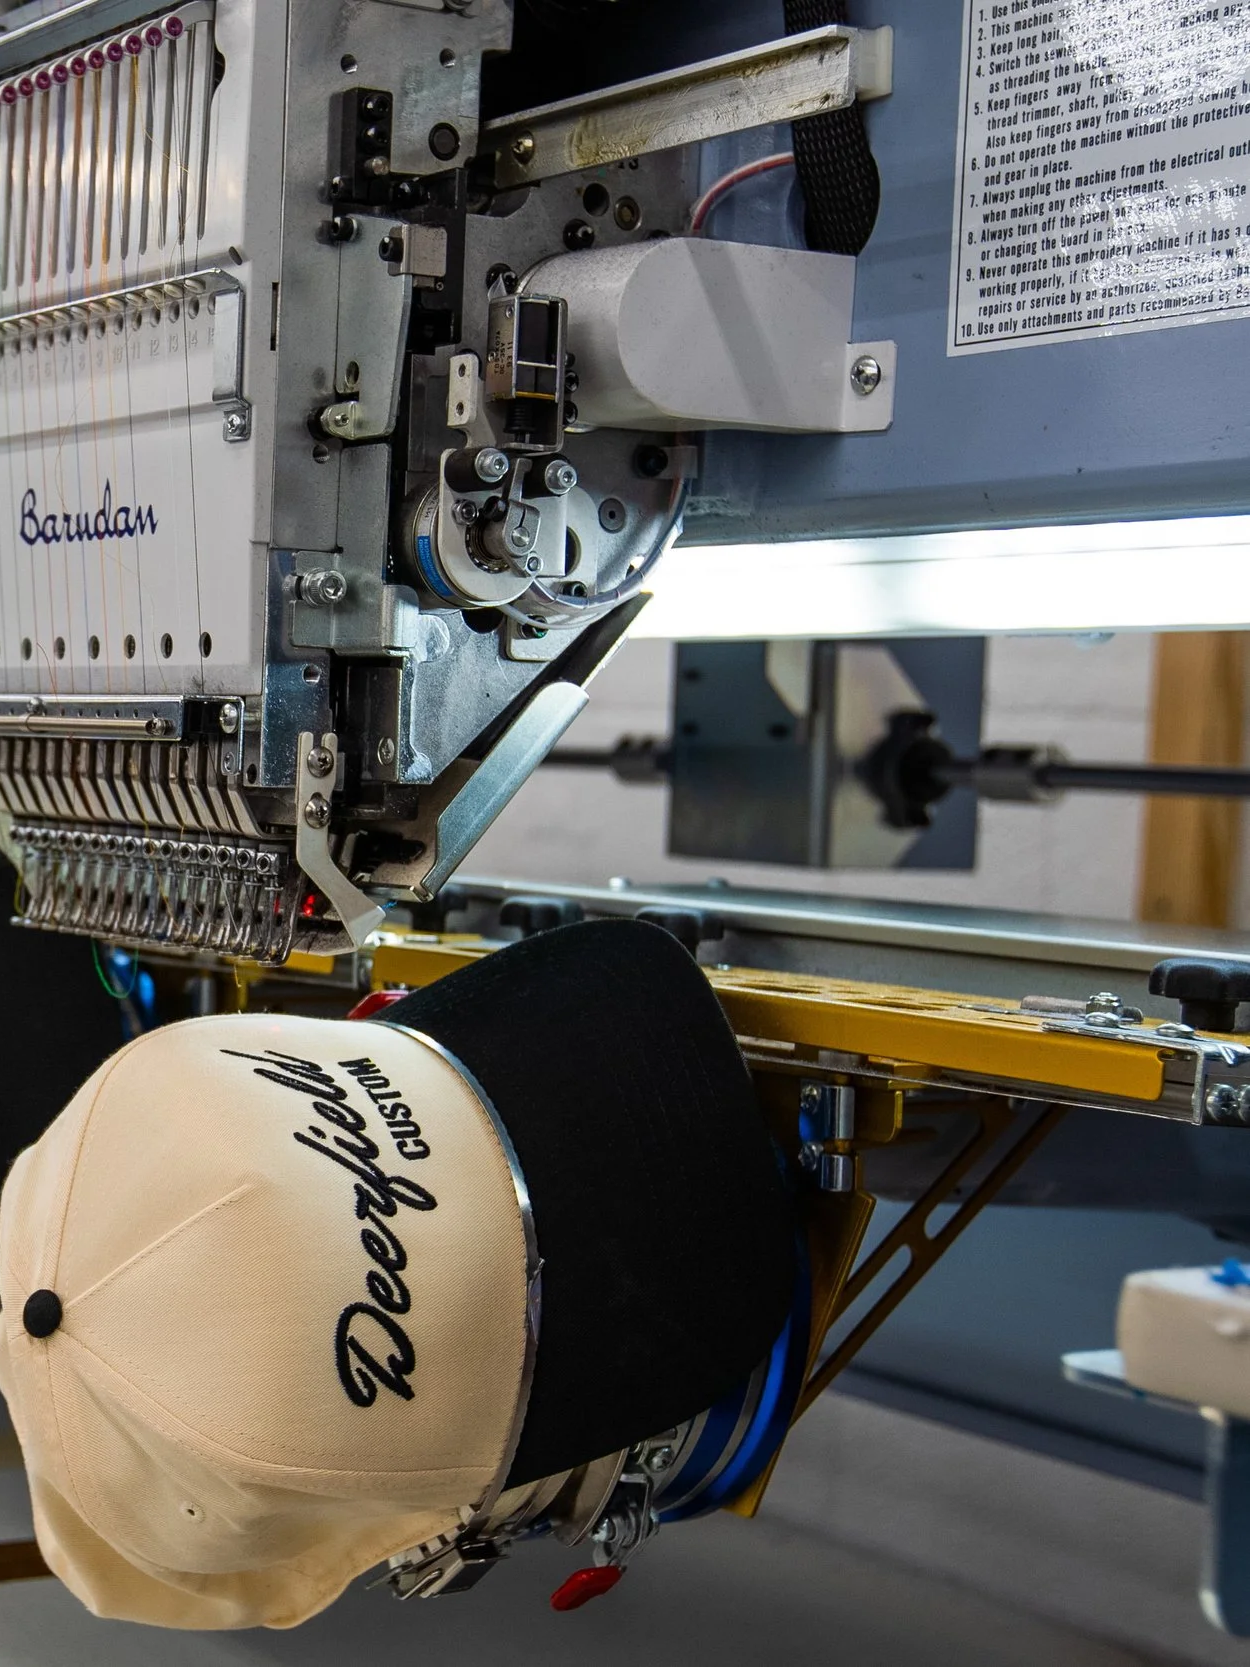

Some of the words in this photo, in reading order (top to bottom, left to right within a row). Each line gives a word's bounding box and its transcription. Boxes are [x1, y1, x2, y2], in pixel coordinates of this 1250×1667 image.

[979, 9, 987, 22] 1.
[992, 5, 1008, 20] Use
[977, 47, 986, 60] 3.
[990, 41, 1013, 57] Keep
[1017, 35, 1037, 49] long
[1042, 28, 1063, 44] hair,
[978, 28, 986, 41] 2.
[991, 23, 1010, 37] This
[976, 65, 985, 78] 4.
[989, 56, 1021, 76] Switch
[1025, 53, 1040, 67] the
[989, 82, 1000, 93] as
[1004, 70, 1050, 90] threading
[1054, 64, 1069, 78] the
[974, 102, 983, 115] 5.
[988, 97, 1010, 112] Keep
[1014, 89, 1049, 106] fingers
[1057, 80, 1082, 96] away
[987, 112, 1018, 131] thread
[1022, 105, 1064, 124] trimmer,
[1069, 95, 1098, 113] shaft,
[971, 158, 980, 171] 6.
[984, 155, 996, 168] Do
[1000, 151, 1015, 165] not
[1019, 142, 1056, 162] operate
[1061, 138, 1076, 152] the
[1080, 129, 1122, 148] machine
[1126, 120, 1166, 139] without
[1171, 115, 1188, 130] the
[1193, 100, 1250, 128] protective
[986, 136, 1006, 149] Also
[1010, 130, 1032, 144] keep
[1036, 122, 1071, 138] fingers
[1076, 115, 1101, 129] away
[1106, 109, 1129, 124] from
[970, 194, 978, 208] 7.
[982, 189, 1015, 205] Always
[1019, 182, 1051, 199] unplug
[1055, 177, 1070, 192] the
[1075, 168, 1116, 188] machine
[1121, 163, 1145, 179] from
[1149, 158, 1166, 174] the
[1171, 145, 1224, 169] electrical
[984, 172, 1001, 187] and
[1005, 169, 1026, 185] gear
[1030, 164, 1039, 177] in
[1043, 160, 1072, 177] place.
[983, 209, 1006, 224] when
[1010, 202, 1044, 219] making
[1049, 198, 1065, 212] any
[1100, 180, 1168, 202] adjustments.
[968, 232, 976, 245] 8.
[981, 227, 1013, 243] Always
[1017, 222, 1037, 236] turn
[1042, 217, 1055, 232] off
[1060, 214, 1075, 229] the
[981, 250, 991, 261] or
[994, 241, 1037, 259] changing
[1041, 237, 1057, 251] the
[1093, 228, 1102, 242] in
[966, 268, 975, 282] 9.
[979, 265, 1006, 280] Never
[1010, 258, 1047, 277] operate
[1052, 254, 1071, 270] this
[1075, 245, 1132, 264] embroidery
[1185, 231, 1194, 246] if
[1198, 229, 1207, 244] it
[1211, 227, 1230, 242] has
[979, 279, 1017, 298] working
[1020, 274, 1065, 294] properly,
[1069, 269, 1077, 284] if
[961, 323, 975, 338] 10.
[978, 322, 994, 336] Use
[998, 318, 1018, 333] only
[1022, 309, 1083, 329] attachments
[1087, 305, 1104, 320] and
[1109, 301, 1136, 320] parts
[978, 300, 1012, 318] repairs
[1016, 299, 1026, 311] or
[1030, 292, 1066, 310] service
[1070, 290, 1081, 304] by
[150, 338, 160, 357] 12
[168, 334, 179, 353] 13
[20, 477, 159, 546] Barudan
[338, 1056, 431, 1161] CUSTOM
[219, 1049, 438, 1408] Deerfield
